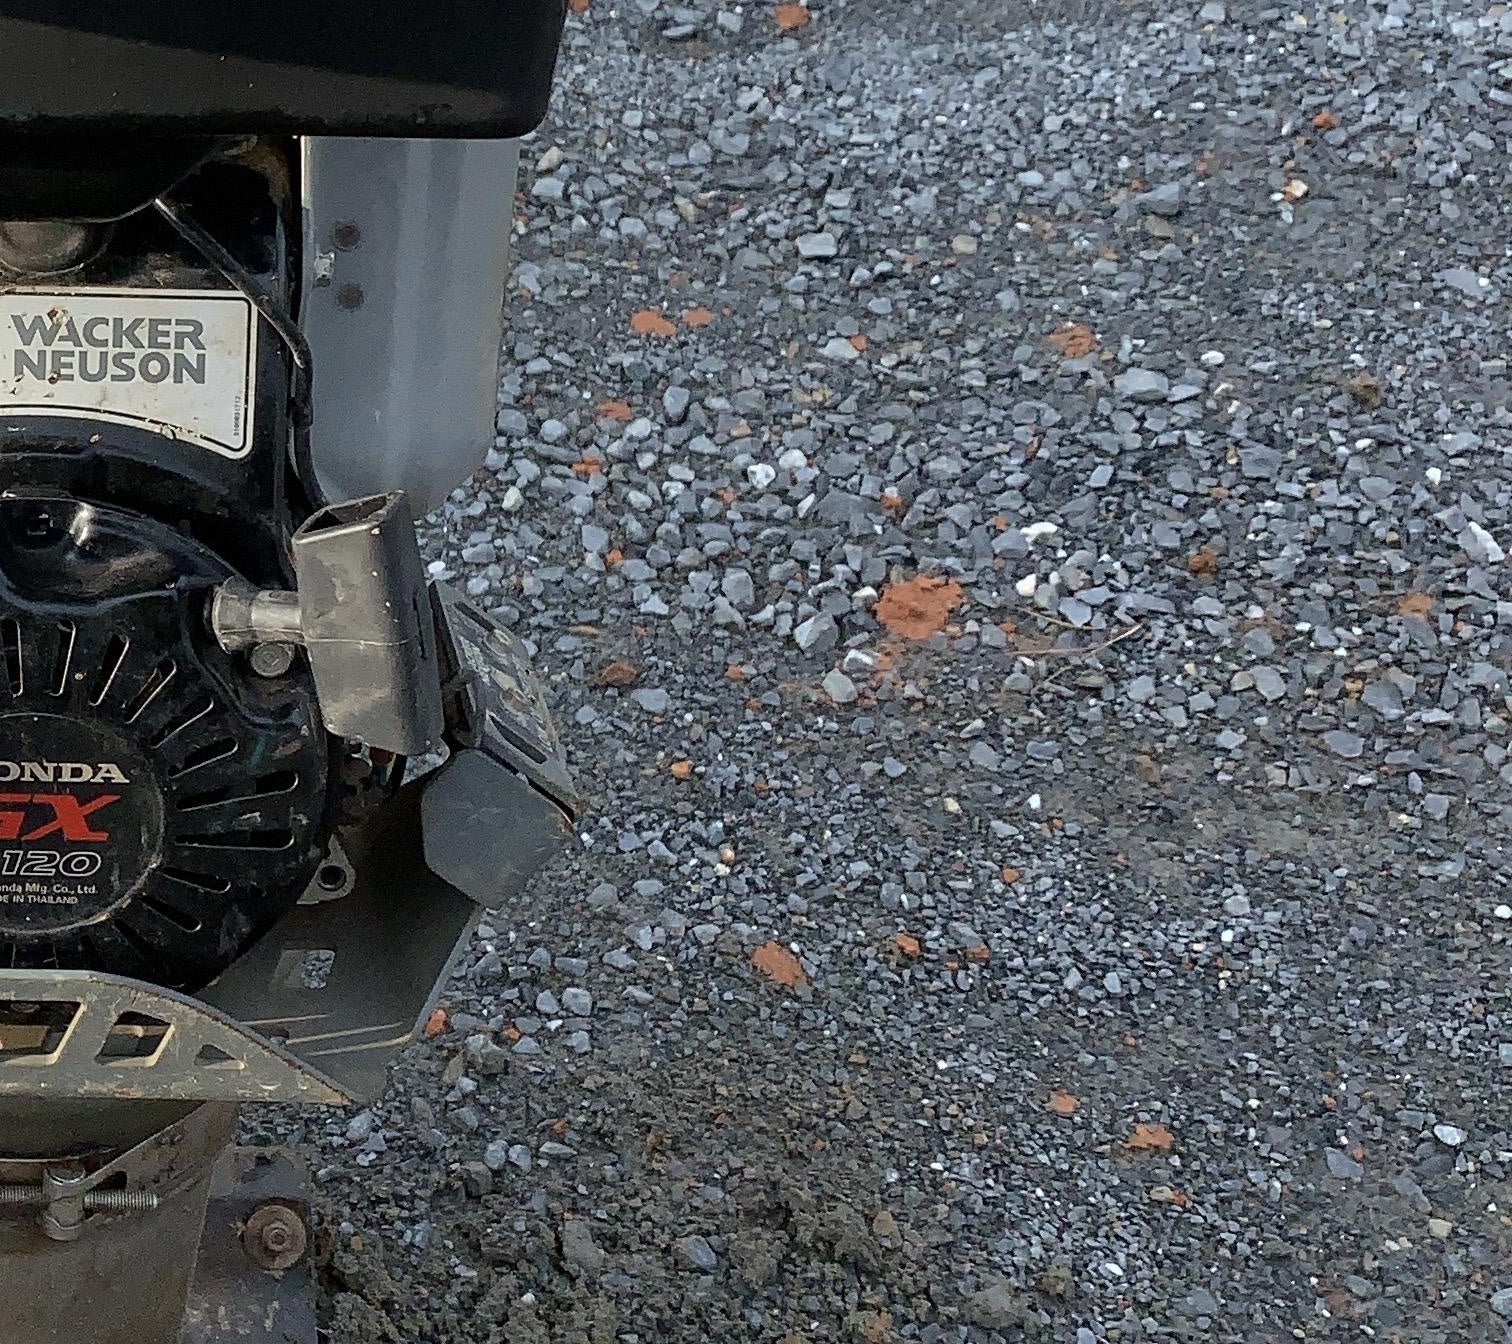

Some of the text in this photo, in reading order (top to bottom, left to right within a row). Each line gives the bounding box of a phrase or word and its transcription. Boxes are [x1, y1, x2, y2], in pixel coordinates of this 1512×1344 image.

[10, 314, 207, 350] WACKER
[13, 349, 207, 384] NEUSON
[13, 895, 24, 903] IN
[28, 895, 79, 905] THAILAND
[52, 884, 75, 895] Co.,
[77, 885, 99, 894] Ltd.
